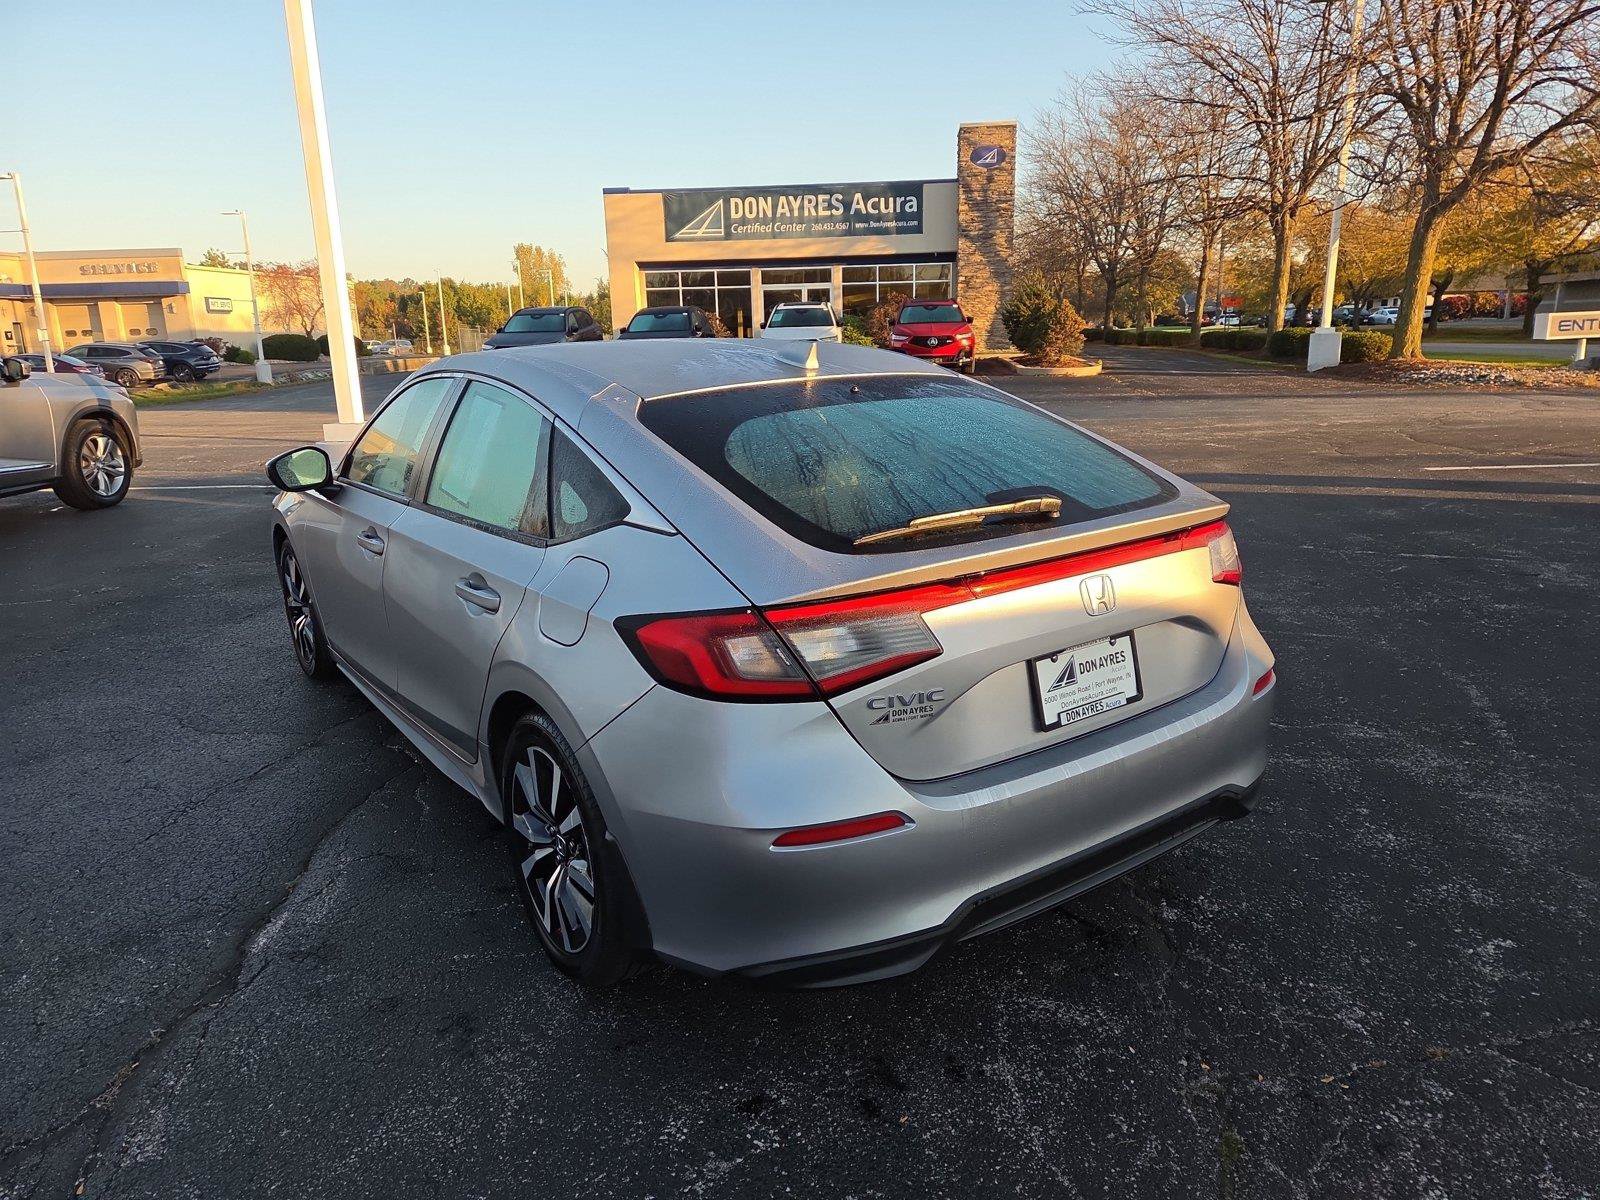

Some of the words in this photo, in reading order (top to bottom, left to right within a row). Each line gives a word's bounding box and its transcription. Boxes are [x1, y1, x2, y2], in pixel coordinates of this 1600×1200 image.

[730, 196, 772, 219] DON
[776, 193, 843, 217] AYRES
[850, 192, 918, 215] Acura
[731, 222, 772, 234] Certified
[774, 221, 806, 232] Center
[1558, 318, 1600, 331] ENT
[1079, 659, 1098, 675] DON
[1098, 650, 1126, 668] AYRES
[1111, 664, 1127, 673] Acura
[866, 687, 945, 710] CIVIC
[1044, 695, 1059, 705] 5000
[1059, 689, 1077, 700] Illinois
[1077, 684, 1091, 694] Road
[1095, 680, 1106, 689] Fort
[1061, 686, 1118, 709] DonAyresAcura.com
[892, 708, 908, 717] DON
[908, 704, 934, 715] AYRES
[1065, 710, 1081, 723] DON
[1081, 701, 1105, 717] AYRES
[1105, 699, 1122, 710] Acura
